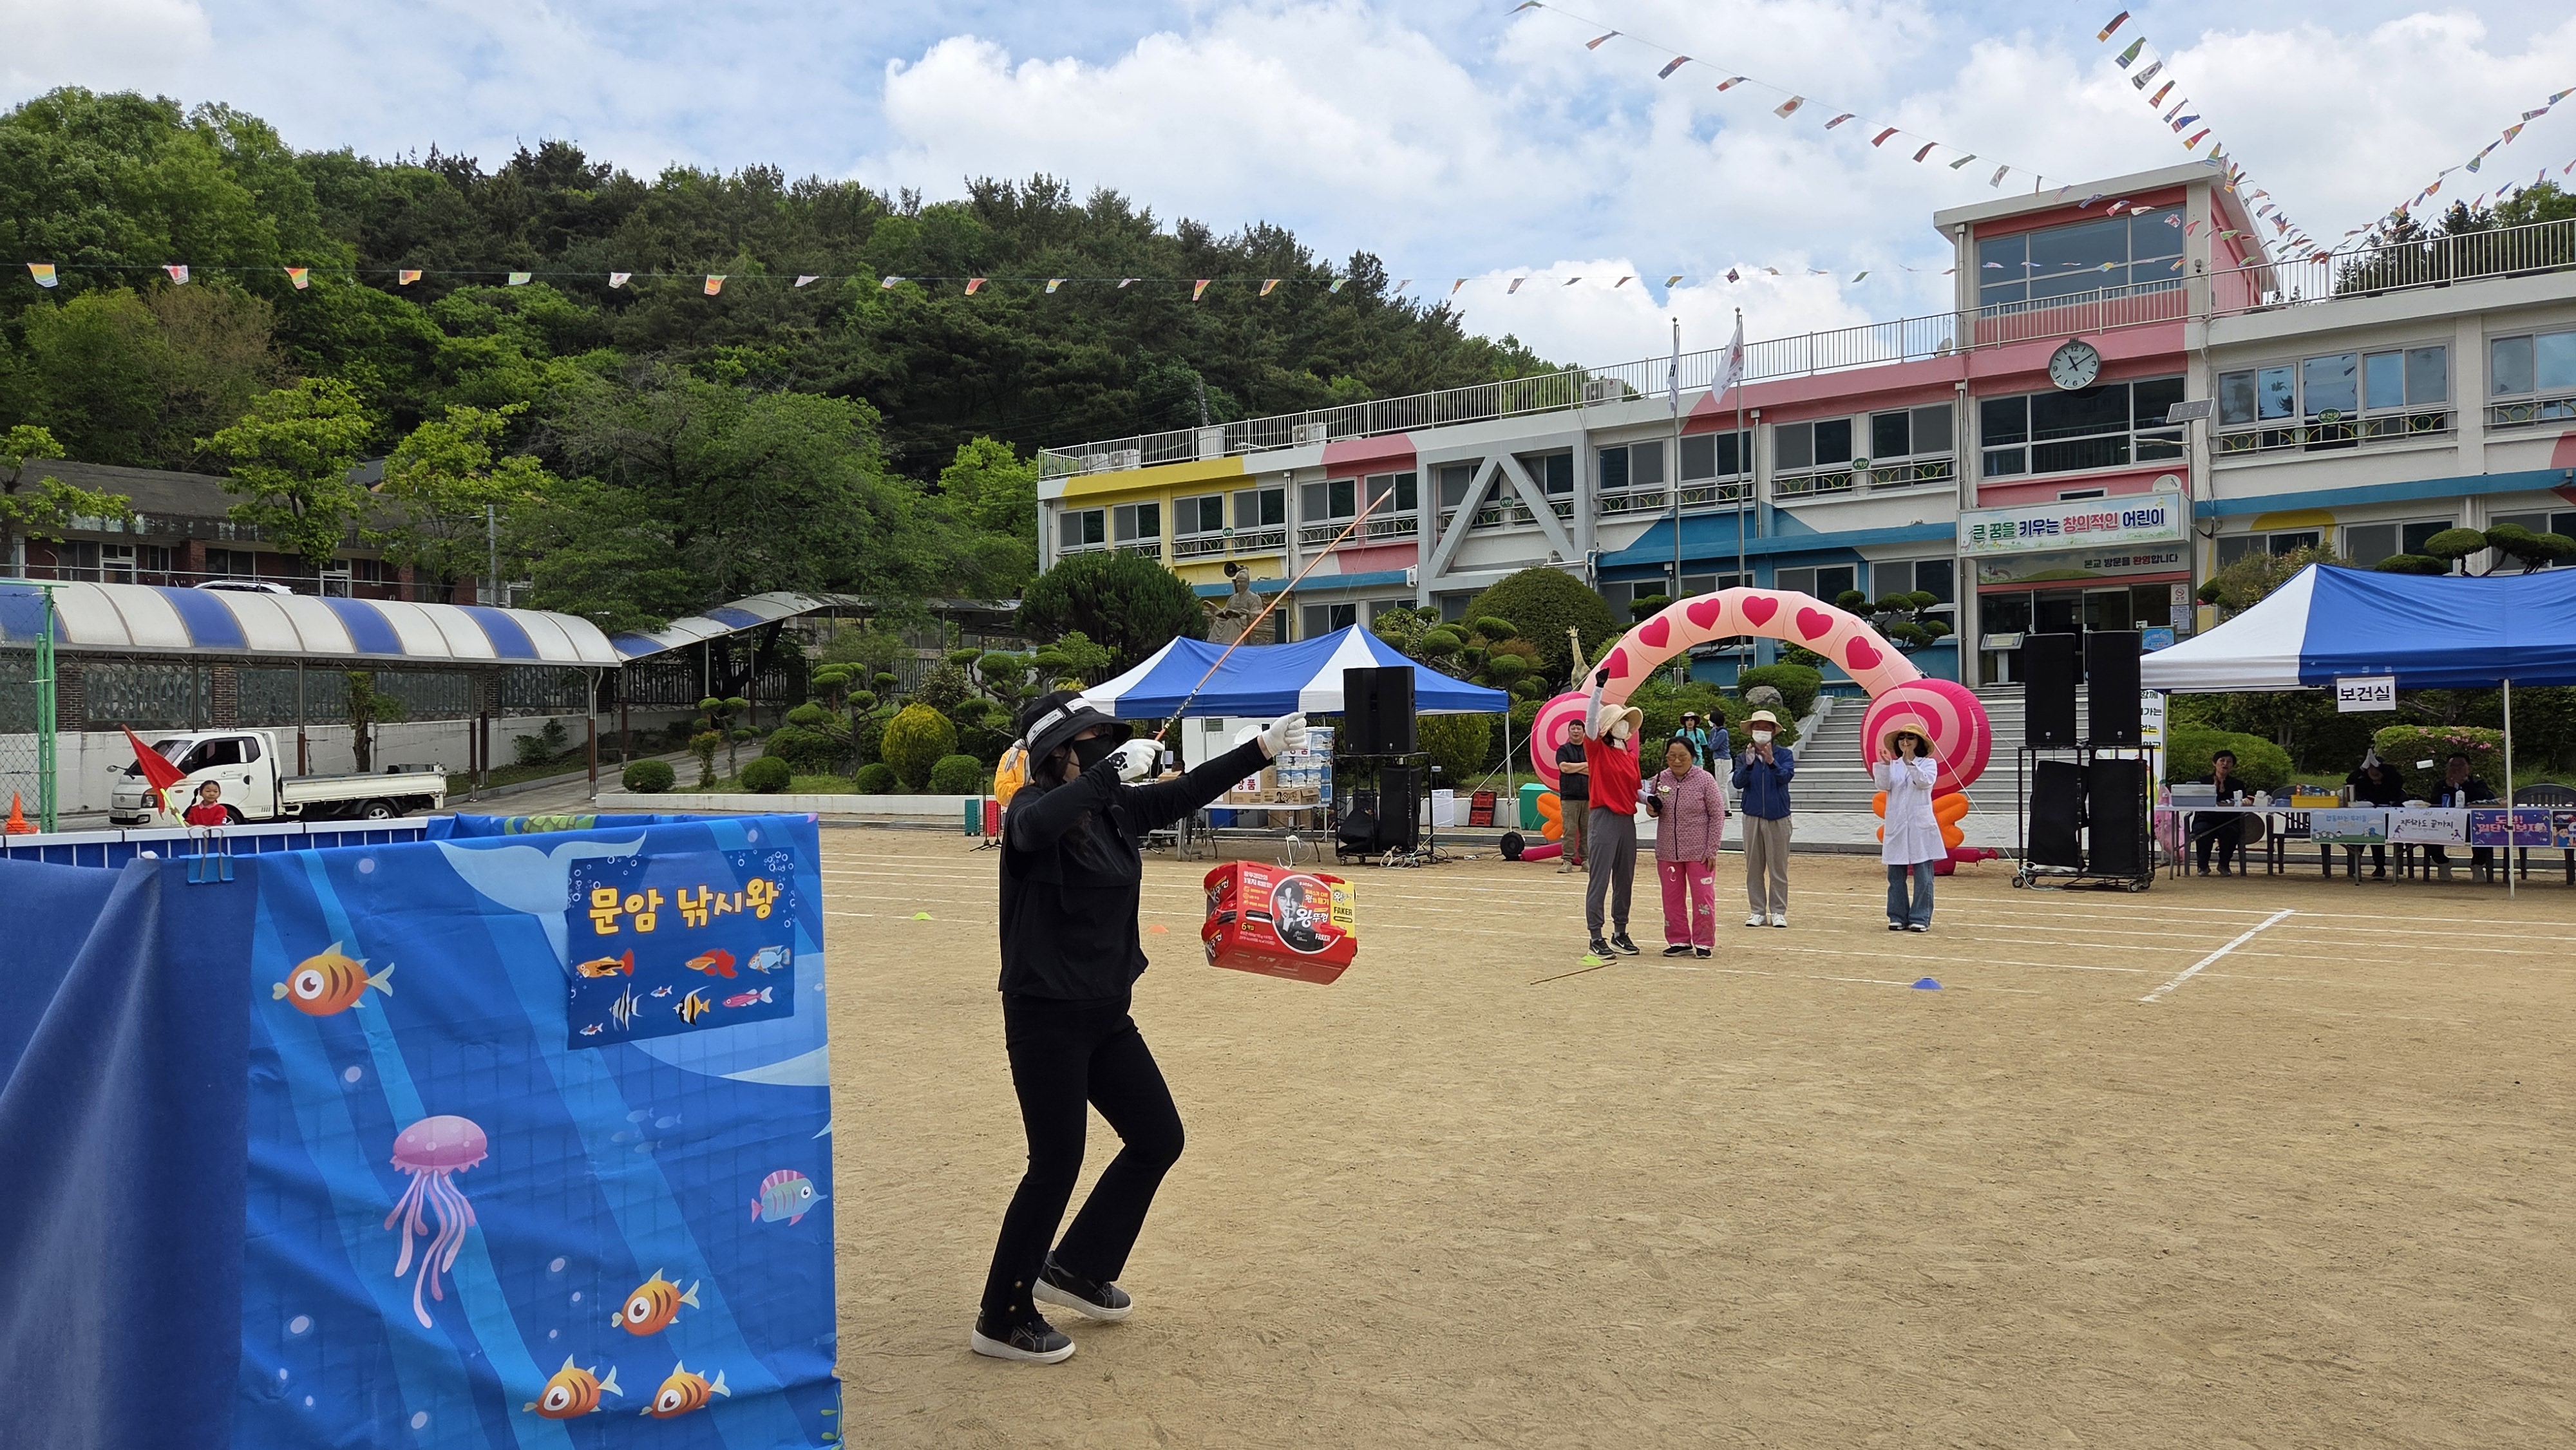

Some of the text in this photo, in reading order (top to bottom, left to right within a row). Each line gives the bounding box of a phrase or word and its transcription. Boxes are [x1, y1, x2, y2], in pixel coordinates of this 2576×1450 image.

[1973, 507, 2164, 540] 큰 꿈을 키우는 창의적인 어린이
[2084, 553, 2179, 569] 본교 방문을 환영합니다
[2339, 685, 2391, 702] 보건실
[589, 876, 780, 935] 문암 낚시왕
[1333, 906, 1352, 916] FAKER
[1296, 908, 1329, 928] 왕뚜껑
[1314, 932, 1331, 942] FAKER
